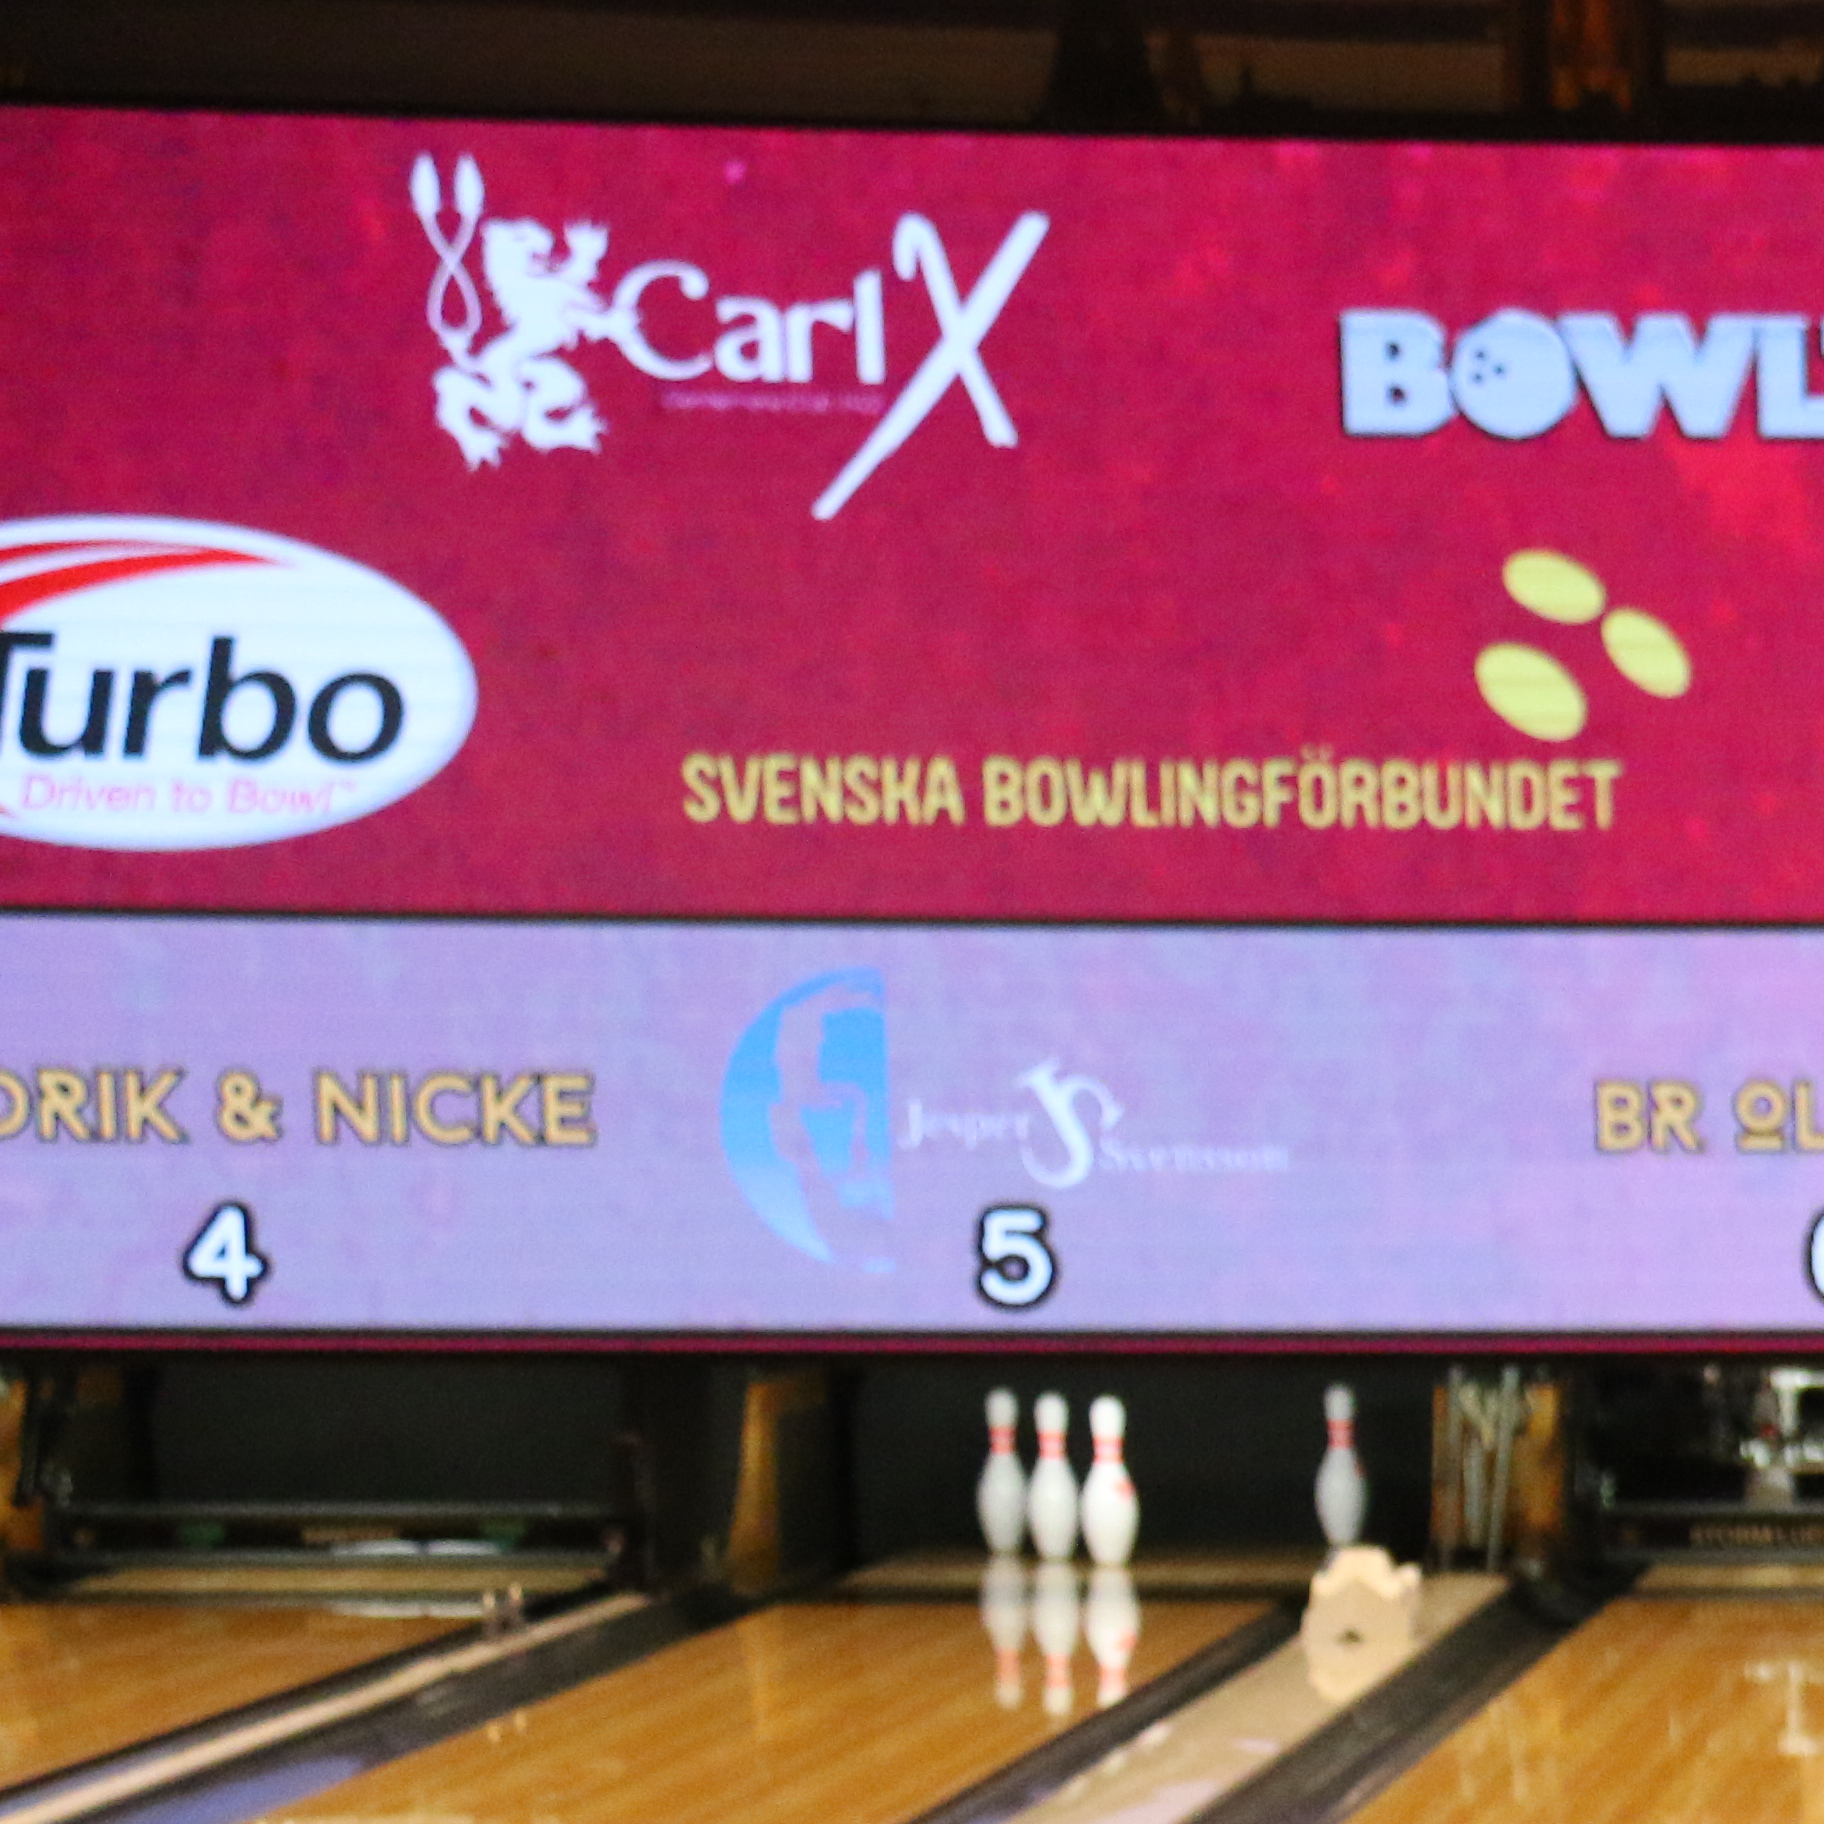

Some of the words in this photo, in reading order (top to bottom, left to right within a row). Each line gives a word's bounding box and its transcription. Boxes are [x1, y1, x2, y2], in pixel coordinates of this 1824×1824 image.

[0, 630, 406, 763] Turbo
[21, 772, 157, 812] Driven
[171, 778, 213, 814] to
[681, 752, 966, 826] SVENSKA
[981, 742, 1622, 831] BOWLINGFÖRBUNDET
[215, 1067, 284, 1143] &
[311, 1069, 600, 1146] NICKE
[1594, 1077, 1704, 1154] BR
[182, 1200, 271, 1305] 4
[975, 1203, 1061, 1311] 5
